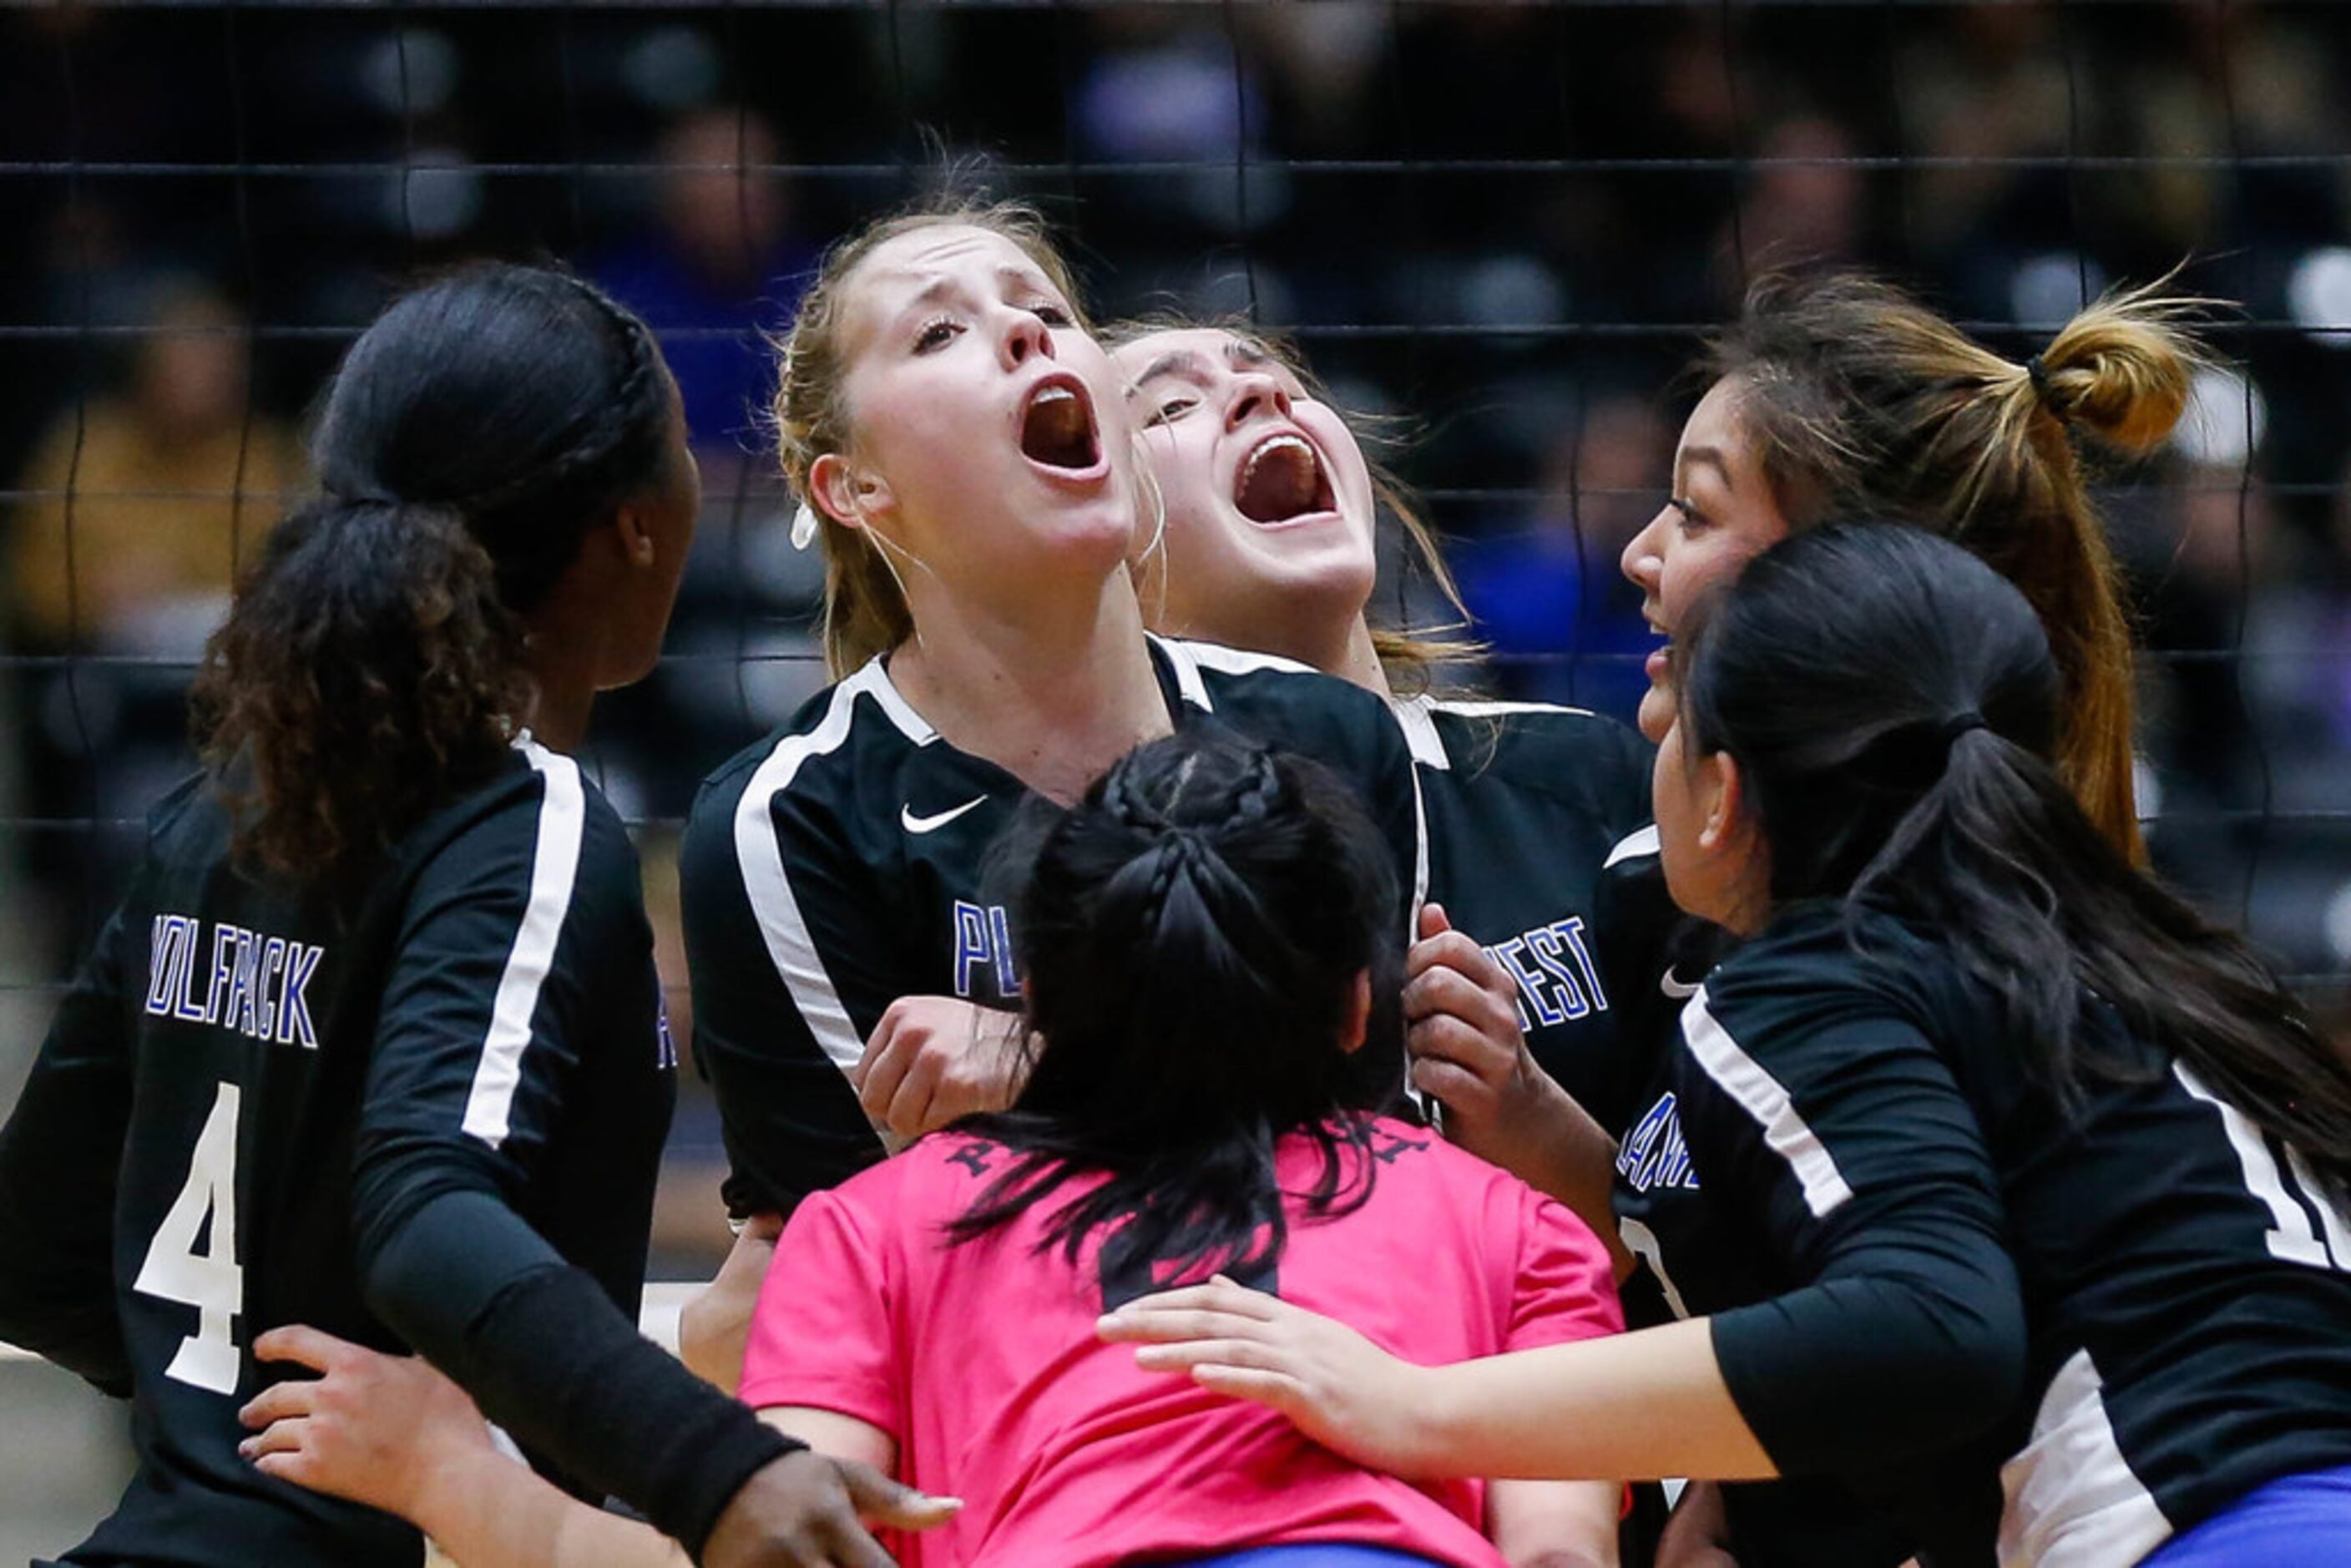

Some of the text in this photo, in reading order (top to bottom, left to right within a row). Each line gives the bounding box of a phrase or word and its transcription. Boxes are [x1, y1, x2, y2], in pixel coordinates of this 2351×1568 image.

[145, 914, 325, 1050] OLFPACK
[1482, 915, 1608, 1032] EST
[133, 1080, 244, 1396] 4
